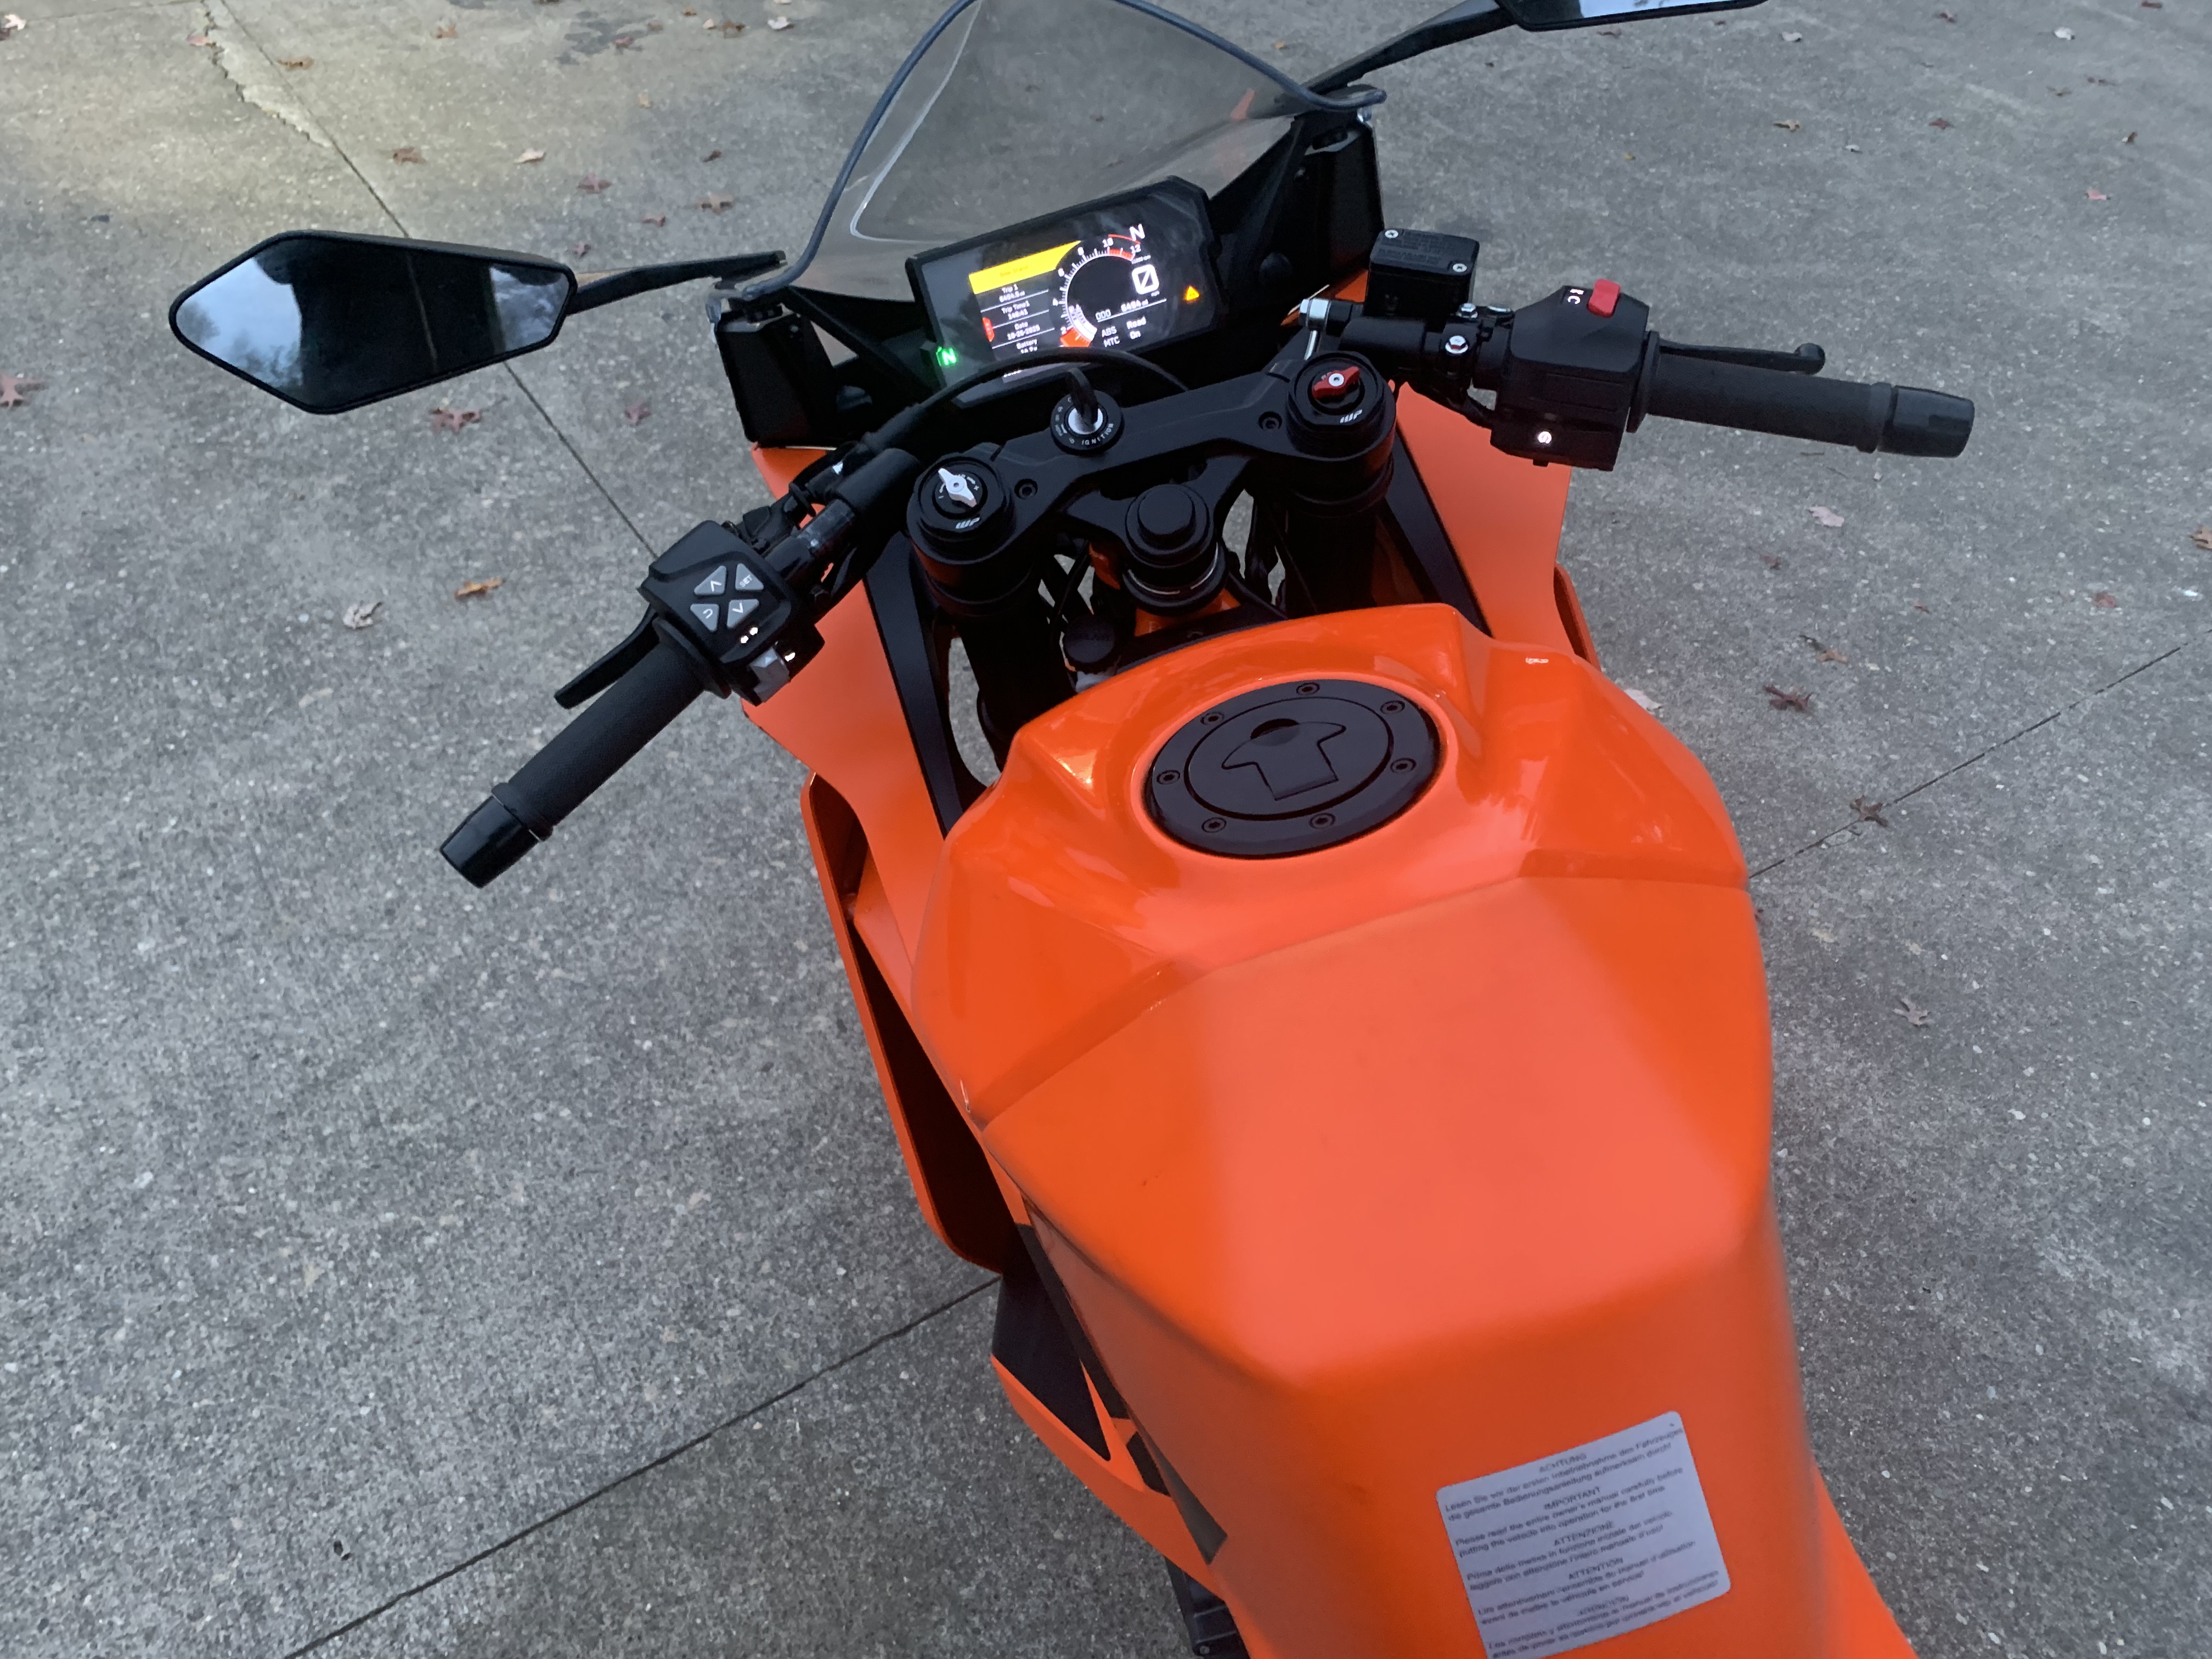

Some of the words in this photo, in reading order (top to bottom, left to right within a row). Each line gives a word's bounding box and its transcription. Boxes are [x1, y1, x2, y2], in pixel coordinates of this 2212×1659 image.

[1129, 224, 1144, 241] N
[1102, 237, 1113, 247] 10
[1130, 244, 1141, 253] 12
[1121, 300, 1141, 312] 6494
[1014, 321, 1028, 330] Date
[1060, 326, 1066, 335] 2
[1102, 326, 1116, 337] ABS
[1126, 317, 1146, 329] Road
[1016, 338, 1037, 349] Battery
[1103, 336, 1119, 347] MTC
[1129, 330, 1141, 339] On
[942, 347, 956, 365] N
[1081, 423, 1114, 445] IGNITION
[739, 574, 753, 588] SET
[1544, 1486, 1599, 1509] IMPORTANT
